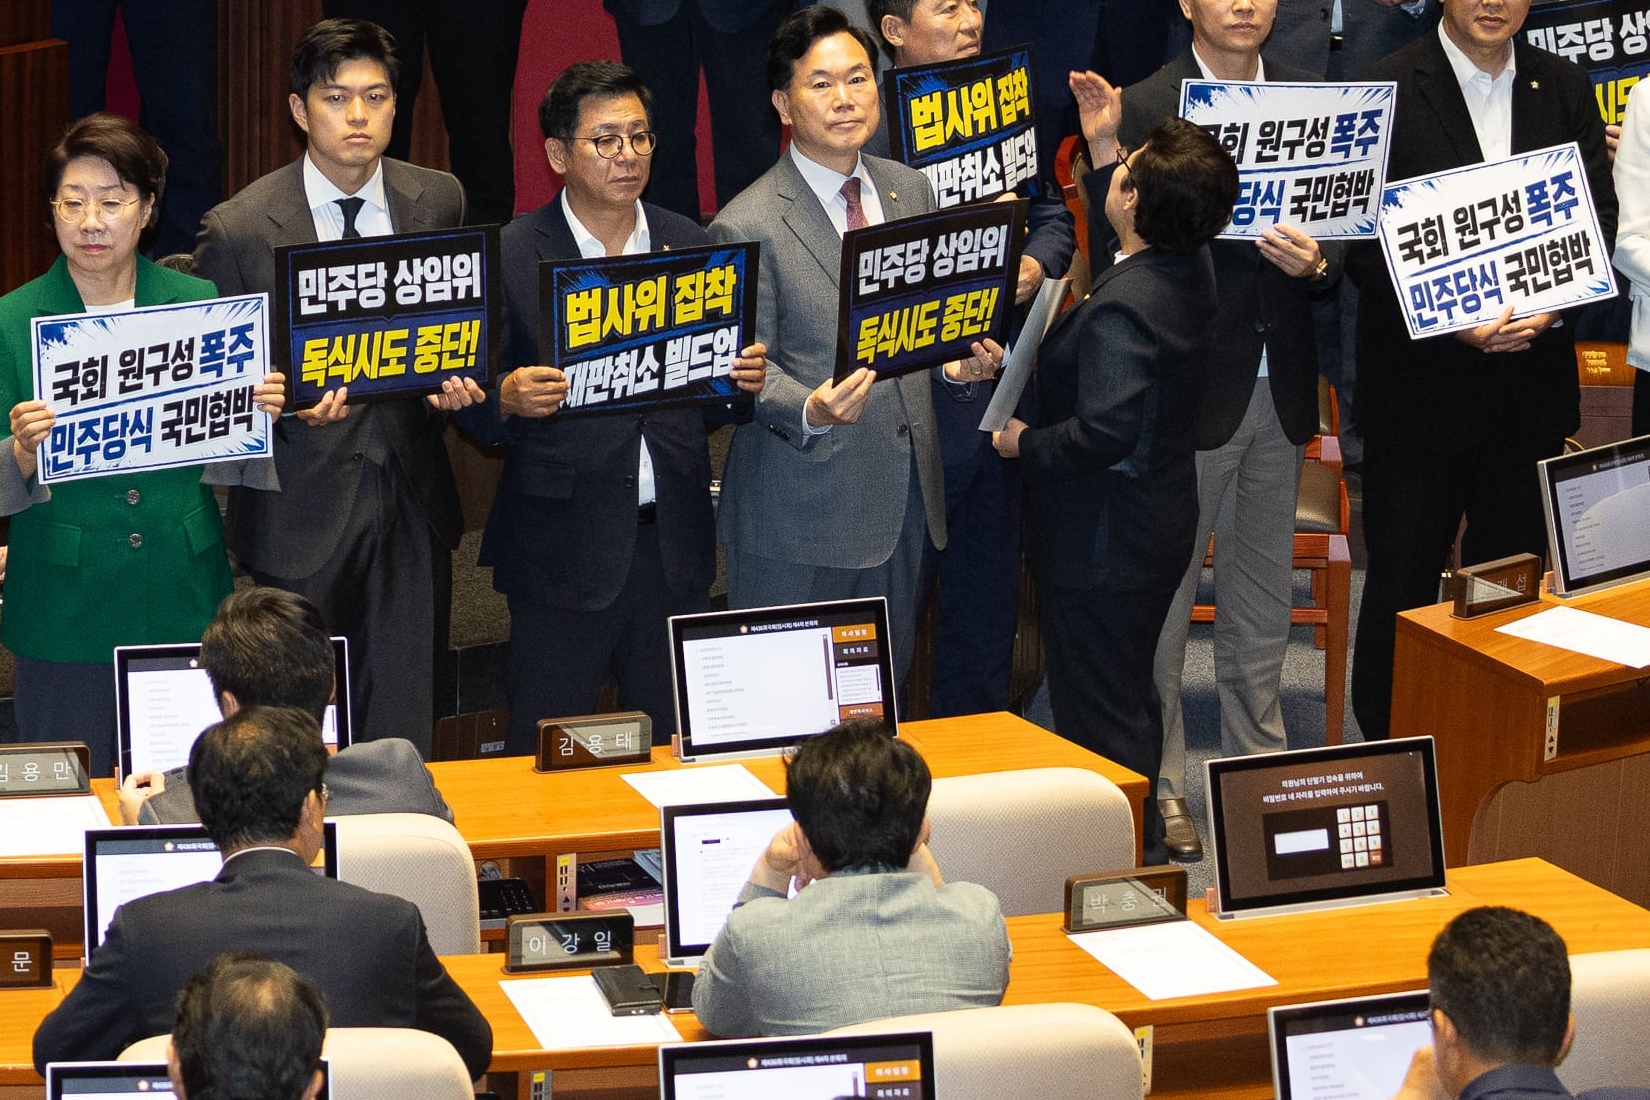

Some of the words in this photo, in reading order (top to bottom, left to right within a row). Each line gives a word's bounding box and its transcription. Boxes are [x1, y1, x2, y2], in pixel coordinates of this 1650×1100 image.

[910, 76, 998, 152] 법사위
[997, 66, 1030, 126] 집착
[1254, 116, 1329, 165] 원구성
[1330, 108, 1384, 160] 폭주
[1001, 125, 1038, 195] 빌드업
[1289, 168, 1375, 224] 국민협박
[1396, 218, 1450, 267] 국회
[1453, 189, 1526, 251] 원구성
[1525, 170, 1580, 229] 폭주
[298, 264, 388, 316] 민주당
[392, 251, 482, 306] 상임위
[858, 238, 929, 295] 민주당
[931, 224, 1008, 276] 상임위
[1410, 260, 1504, 330] 민주당식
[1503, 230, 1595, 298] 국민협박
[566, 275, 667, 349] 법사위
[674, 264, 738, 327] 집착
[855, 296, 938, 365] 독식시도
[940, 286, 1000, 340] 중단!
[52, 354, 108, 406] 국회
[117, 336, 195, 391] 원구성
[199, 321, 255, 378] 폭주
[301, 330, 408, 389] 독식시도
[413, 318, 482, 375] 중단!
[559, 344, 661, 409] 재판취소
[665, 324, 740, 391] 빌드업
[51, 406, 153, 475] 민주당식
[161, 386, 256, 449] 국민협박
[528, 930, 613, 956] 이강일
